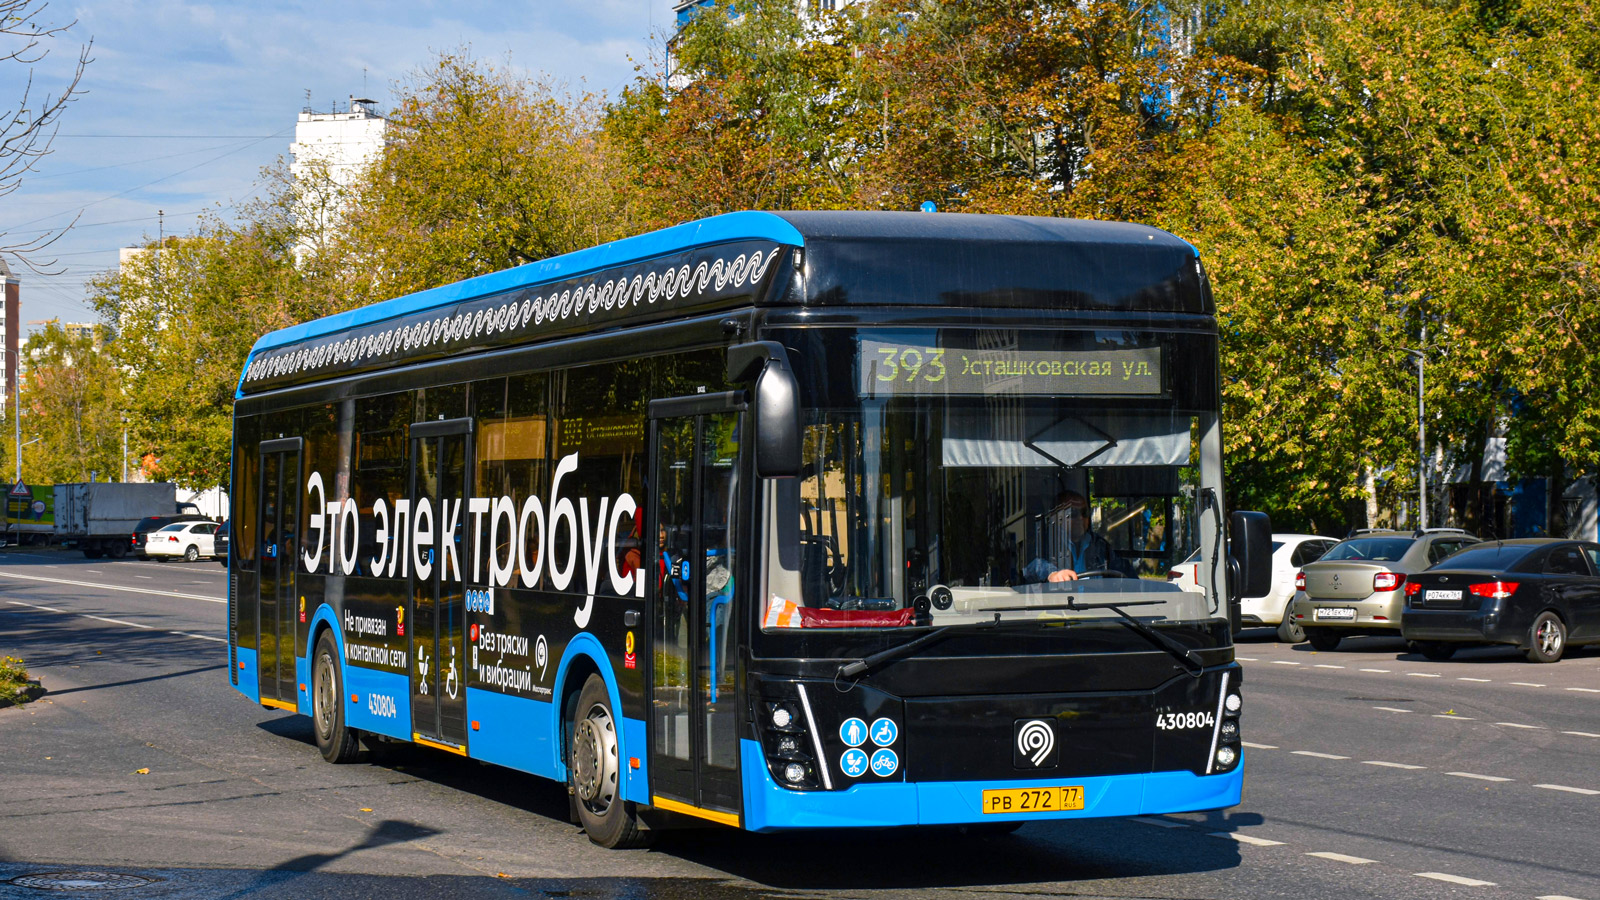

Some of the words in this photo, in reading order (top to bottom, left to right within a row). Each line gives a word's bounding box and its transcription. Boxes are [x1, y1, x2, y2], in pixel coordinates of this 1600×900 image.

[876, 348, 946, 382] 393
[1122, 360, 1152, 381] ул.
[304, 471, 359, 576] Это
[370, 451, 646, 629] электробус.
[344, 609, 354, 632] Не
[355, 616, 387, 638] привязан
[344, 643, 349, 659] к
[350, 643, 389, 666] контактной
[389, 649, 407, 669] сети
[479, 625, 496, 651] Без
[496, 633, 528, 659] тряски
[479, 664, 485, 683] и
[486, 660, 531, 693] вибраций
[368, 693, 397, 718] 430804
[1156, 711, 1214, 730] 430804
[991, 796, 1012, 811] РВ
[1020, 790, 1052, 809] 272
[1062, 788, 1078, 802] 77
